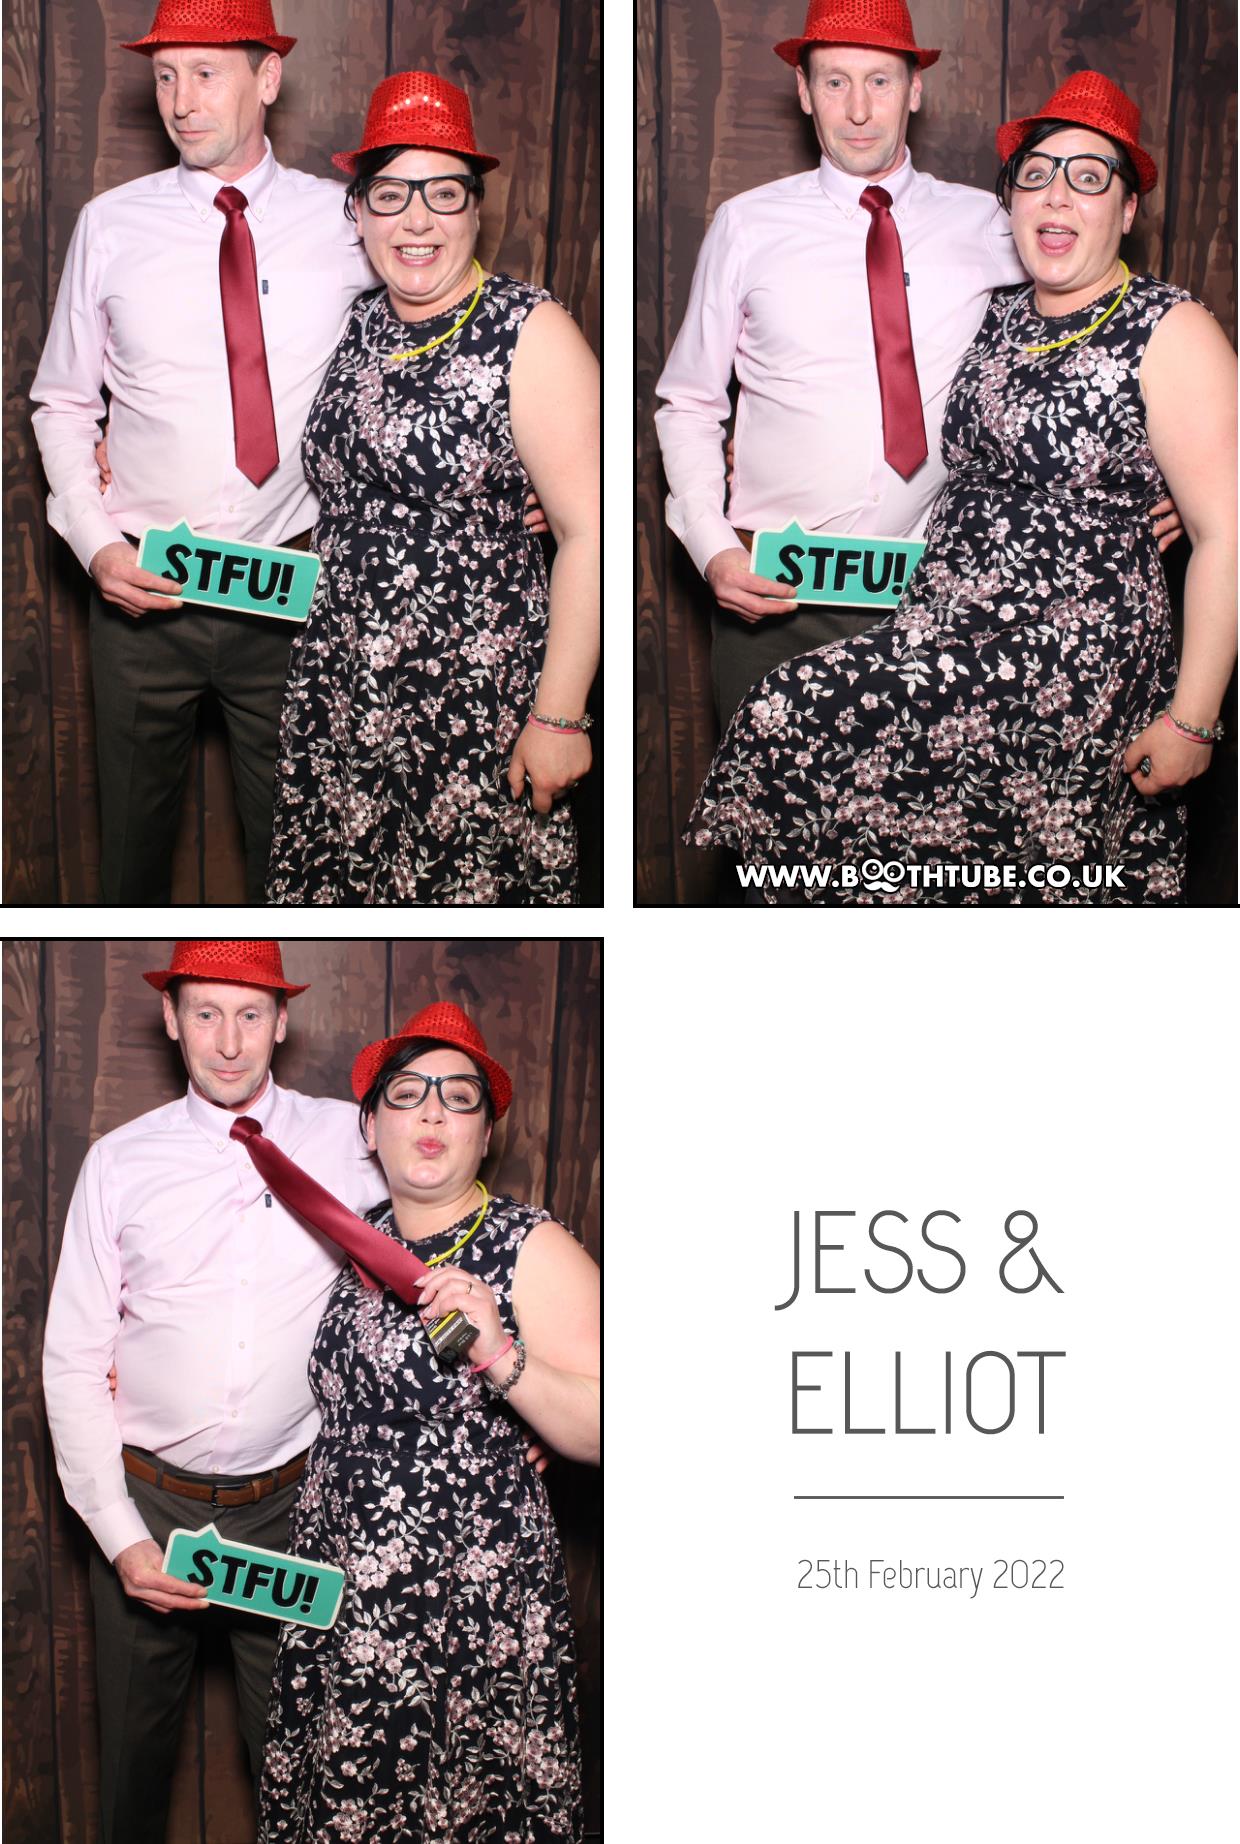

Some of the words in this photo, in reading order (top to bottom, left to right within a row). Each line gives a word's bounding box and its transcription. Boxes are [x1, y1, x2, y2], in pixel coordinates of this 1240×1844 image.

[161, 543, 295, 606] STFU!
[775, 543, 907, 596] STFU!
[186, 1548, 320, 1614] STFU!
